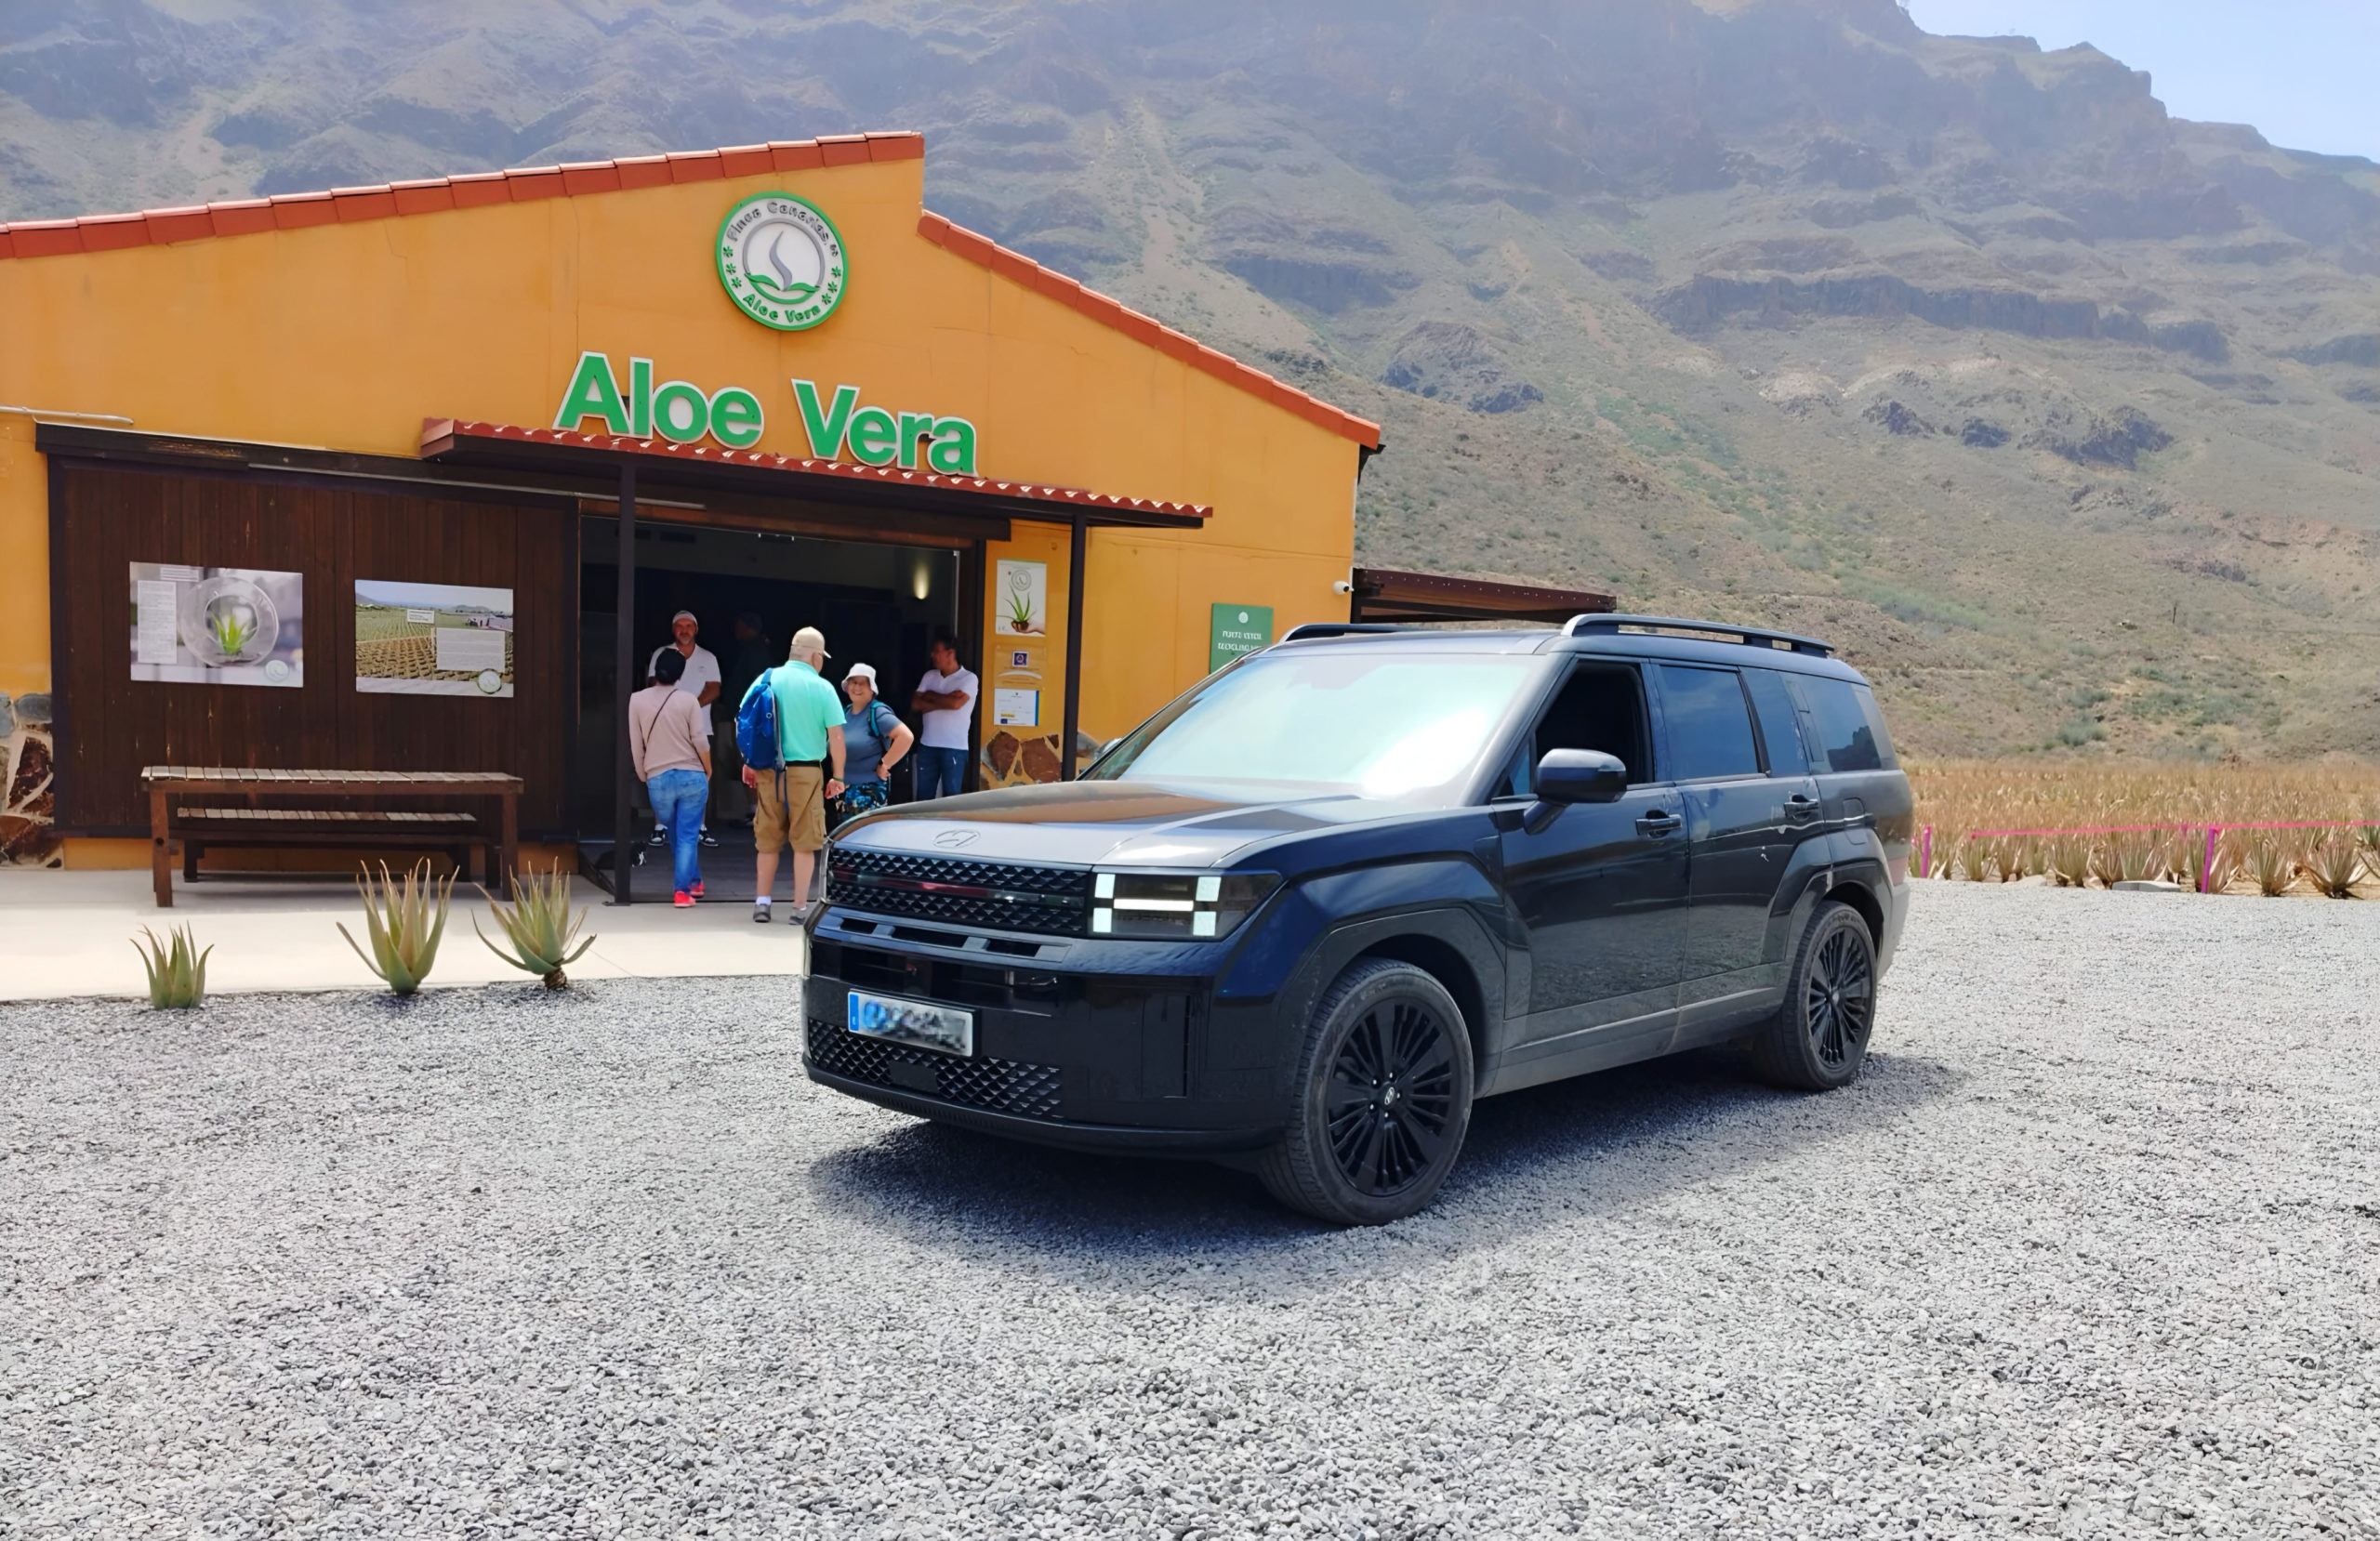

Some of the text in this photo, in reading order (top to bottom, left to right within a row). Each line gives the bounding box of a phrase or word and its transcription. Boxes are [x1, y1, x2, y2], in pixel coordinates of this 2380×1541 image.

[743, 294, 821, 323] Aloe Vera
[552, 350, 978, 478] Aloe Vera
